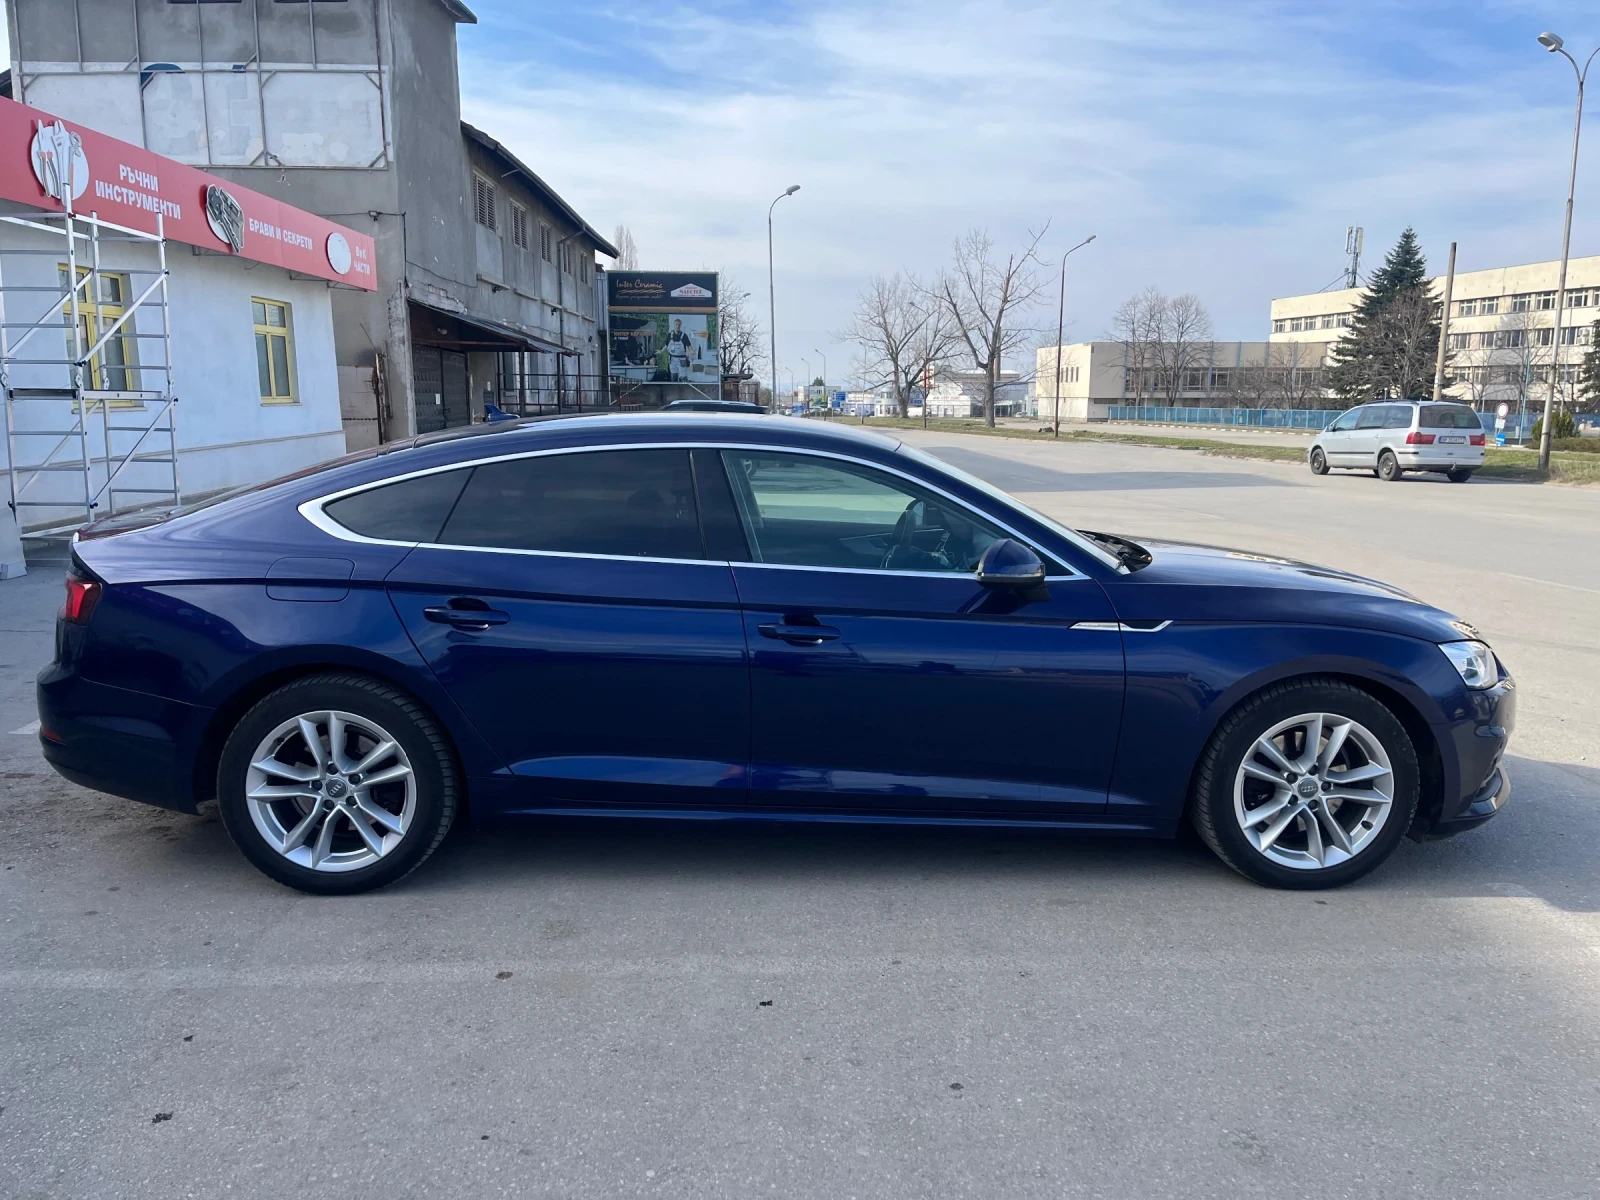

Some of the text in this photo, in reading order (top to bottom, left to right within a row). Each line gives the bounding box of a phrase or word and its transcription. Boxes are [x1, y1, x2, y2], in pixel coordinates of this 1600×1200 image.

[119, 164, 158, 192] РЪЧНИ
[95, 180, 181, 220] ИНСТРУМЕНТИ
[249, 217, 313, 250] БРАВИ И СЕКРЕТИ
[353, 260, 371, 275] ЧАСТИ
[634, 279, 663, 289] Ceramic
